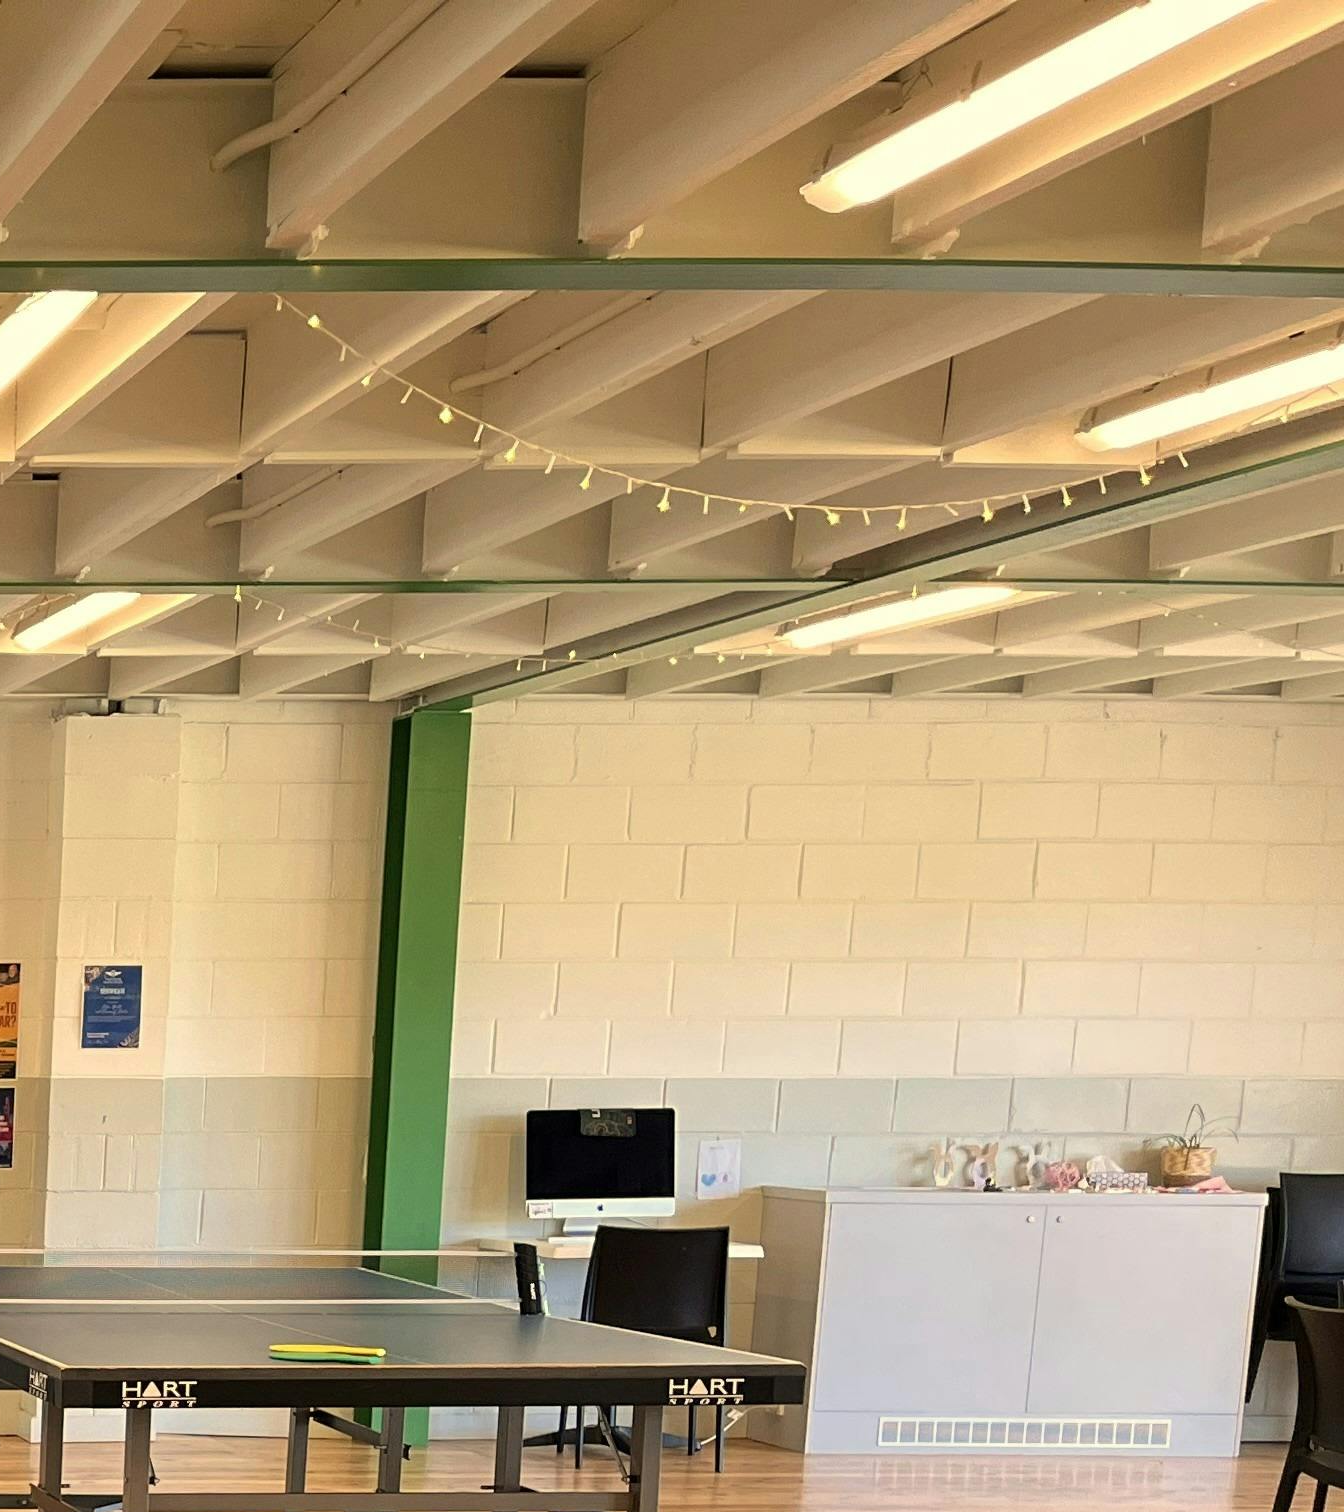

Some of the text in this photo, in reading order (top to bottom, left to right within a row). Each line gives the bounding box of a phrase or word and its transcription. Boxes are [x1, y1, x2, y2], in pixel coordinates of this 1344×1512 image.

[6, 1002, 17, 1014] TO
[121, 1380, 198, 1398] HART
[668, 1378, 746, 1395] HART
[121, 1400, 197, 1408] SPORT
[668, 1397, 744, 1405] SPORT
